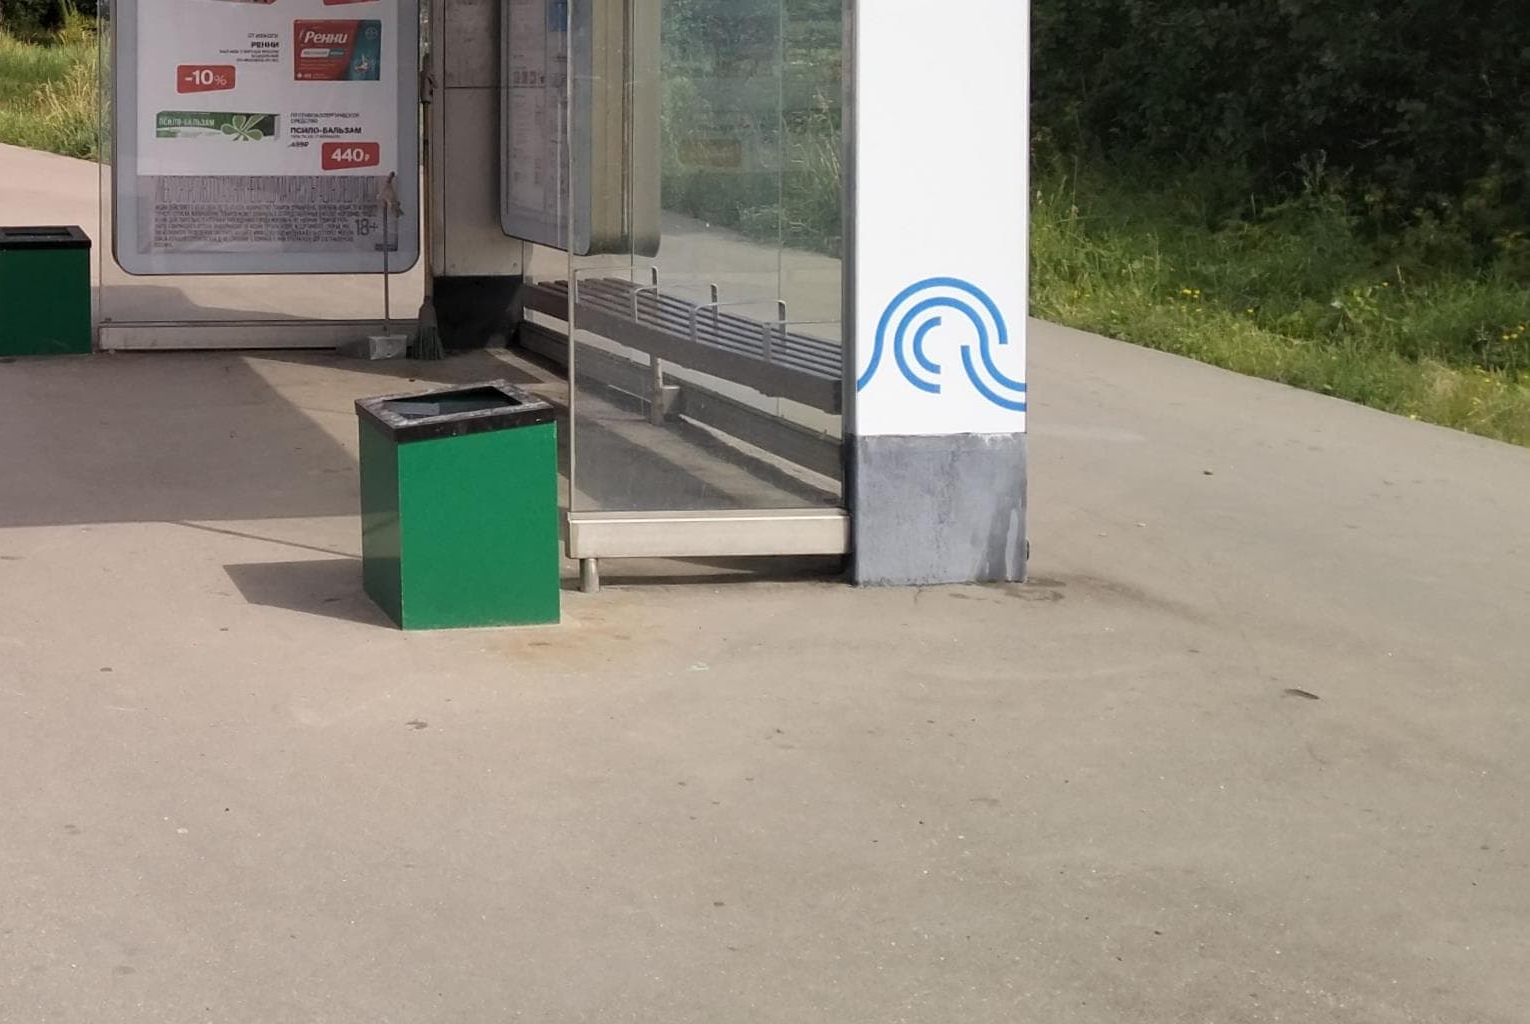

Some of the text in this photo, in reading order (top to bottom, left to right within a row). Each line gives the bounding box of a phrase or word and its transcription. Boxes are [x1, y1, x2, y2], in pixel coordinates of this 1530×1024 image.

[304, 31, 348, 44] Ренни
[185, 69, 227, 86] -10%
[356, 218, 378, 236] 18+
